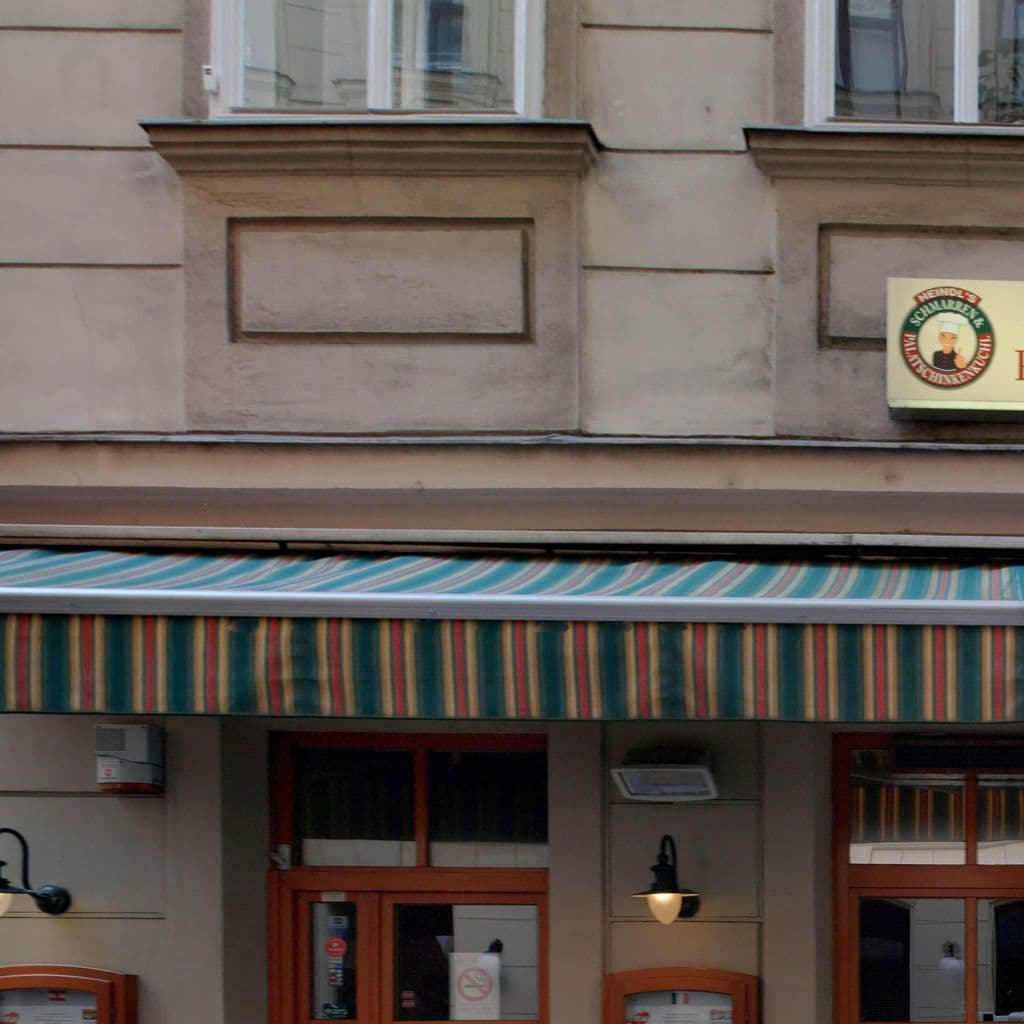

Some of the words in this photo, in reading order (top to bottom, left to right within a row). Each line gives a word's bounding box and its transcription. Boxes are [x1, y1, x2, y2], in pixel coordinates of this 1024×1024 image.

[918, 287, 978, 304] HEINDL'S
[909, 299, 979, 327] SCHMARREN
[972, 317, 985, 329] &
[903, 333, 992, 385] PALATSCHINKENKUCHL
